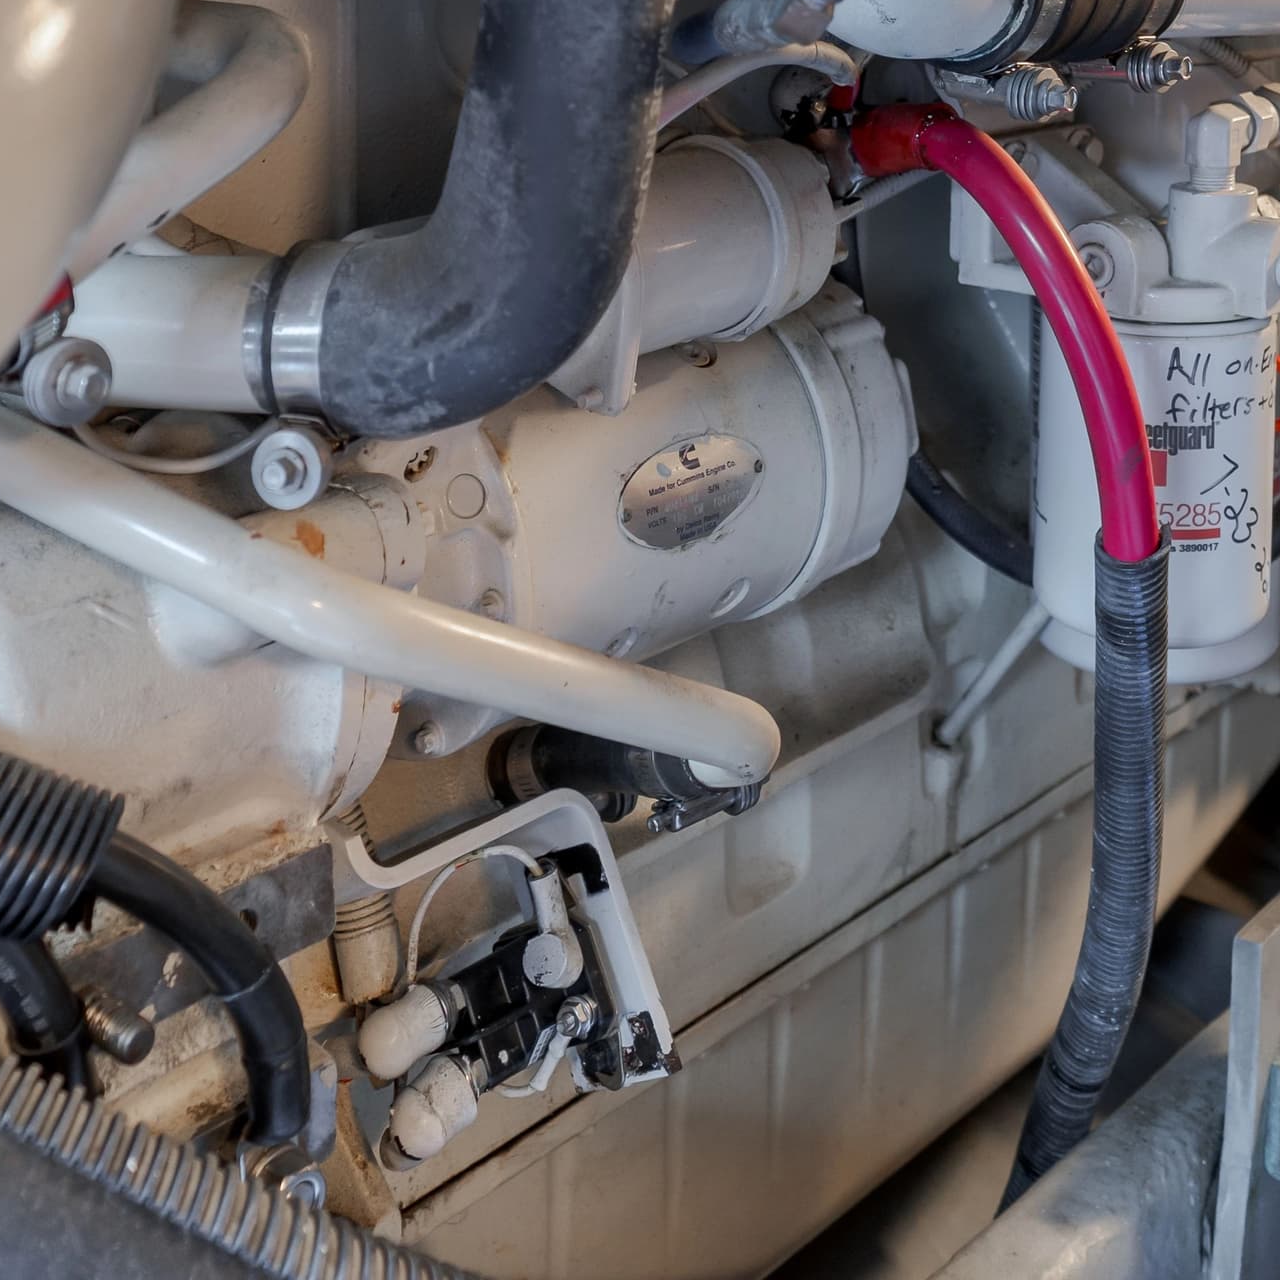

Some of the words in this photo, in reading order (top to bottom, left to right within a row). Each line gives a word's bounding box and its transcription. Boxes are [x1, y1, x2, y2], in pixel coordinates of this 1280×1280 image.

[1167, 346, 1212, 387] All
[1166, 392, 1255, 423] filters
[1145, 422, 1215, 456] eetguard
[648, 485, 666, 496] Made
[666, 482, 676, 491] for
[676, 472, 705, 487] Cummins
[705, 464, 726, 476] Engine
[646, 506, 659, 517] P/N
[1156, 503, 1221, 527] 5285
[1178, 542, 1220, 553] 3890017
